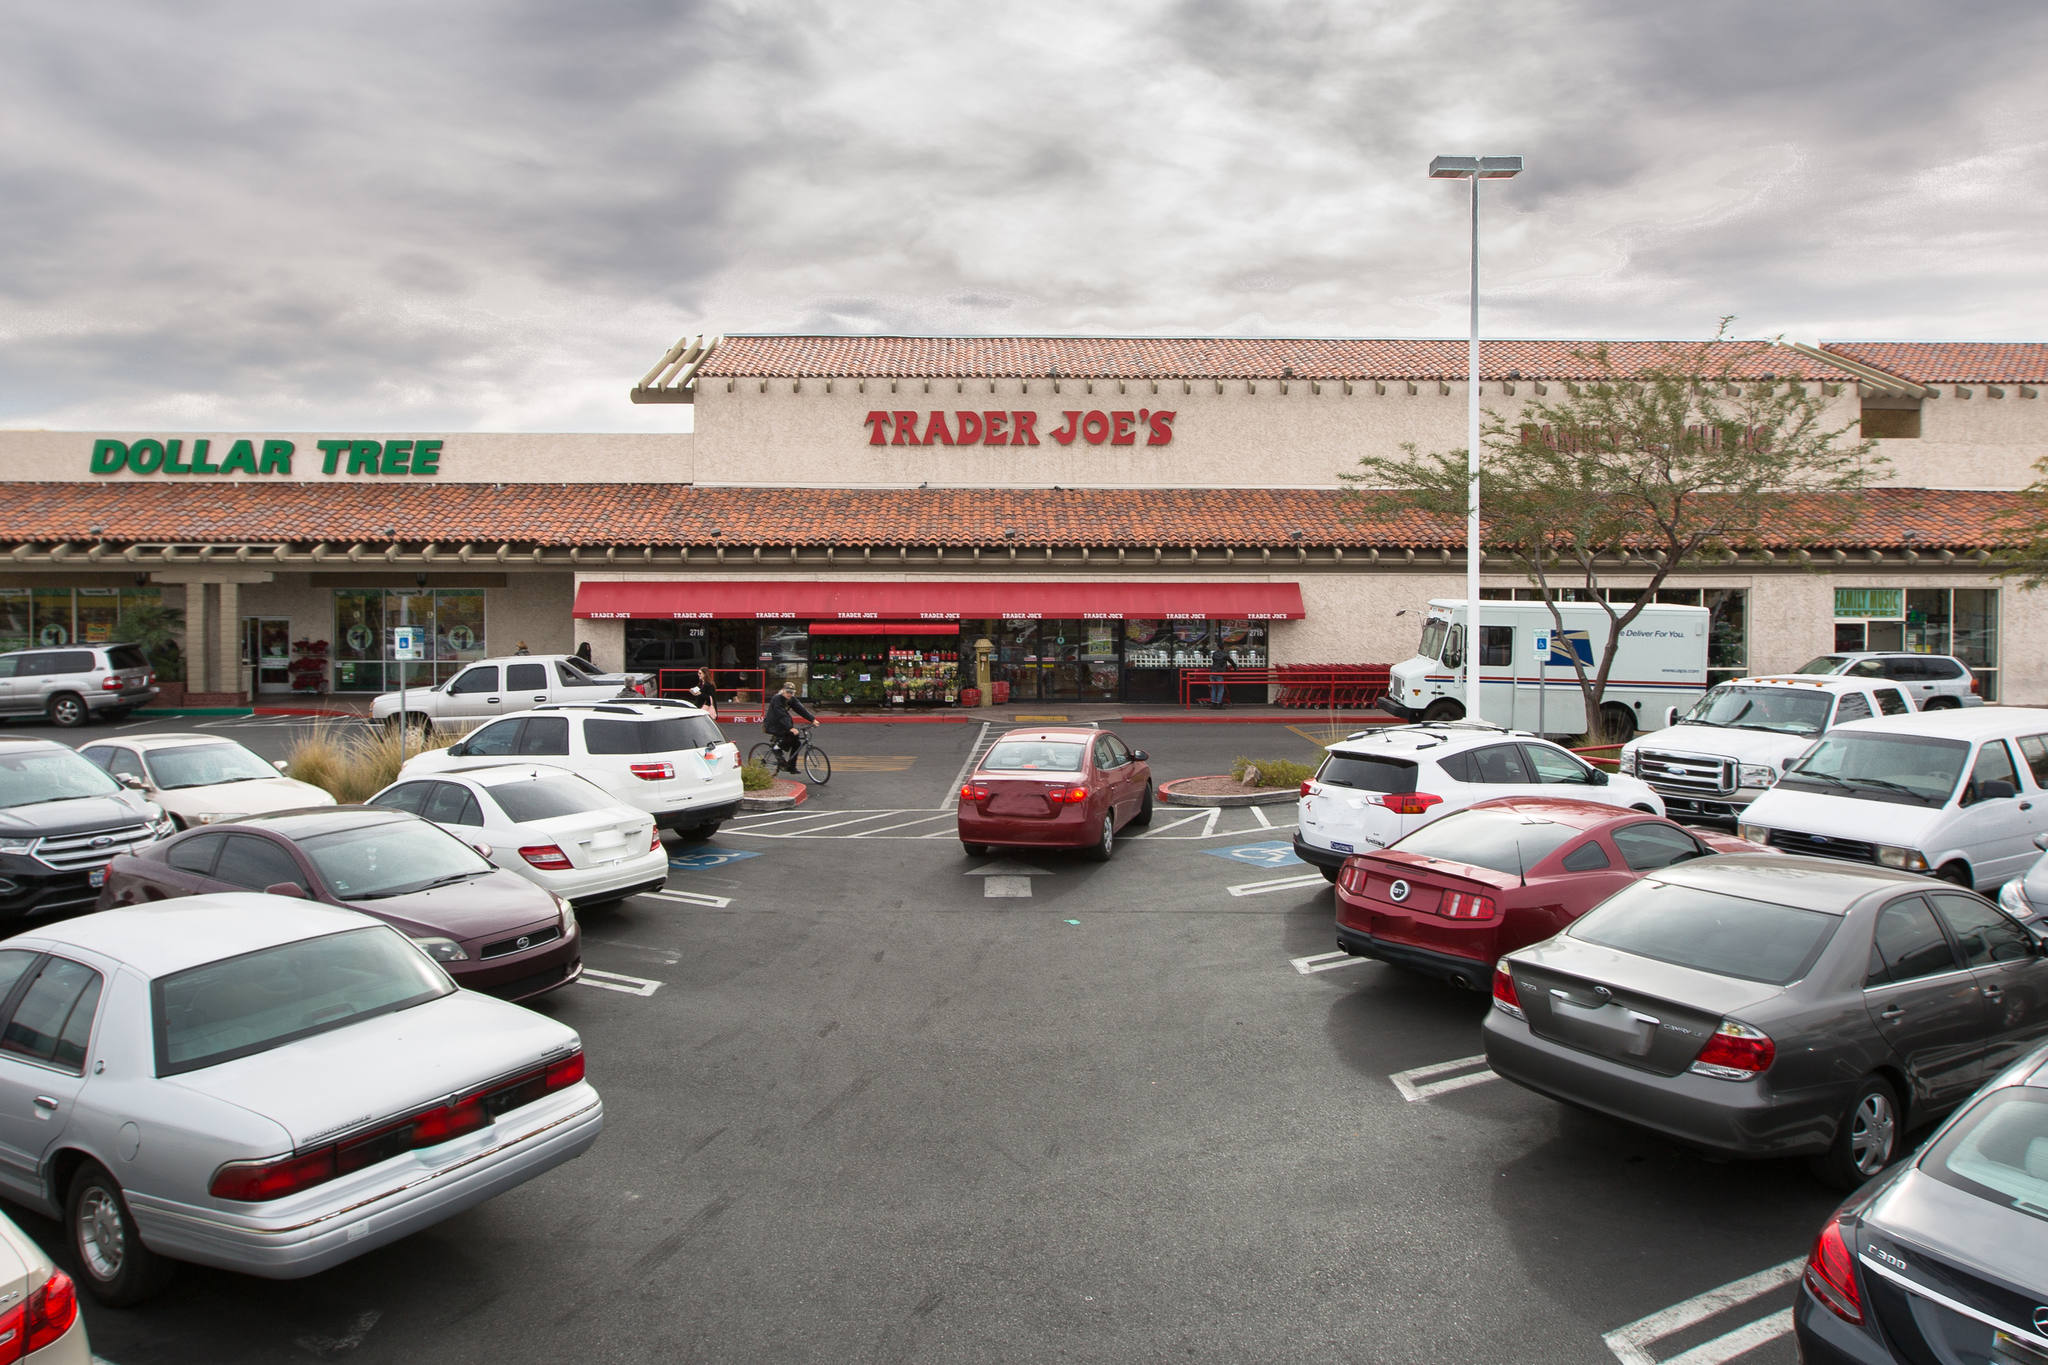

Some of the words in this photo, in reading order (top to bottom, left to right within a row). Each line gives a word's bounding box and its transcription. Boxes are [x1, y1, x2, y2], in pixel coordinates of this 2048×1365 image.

[864, 410, 1041, 446] TRADER
[1049, 408, 1177, 446] JOE'S
[89, 438, 295, 476] DOLLAR
[317, 439, 444, 476] TREE
[1834, 590, 1866, 609] FAMILY
[1869, 590, 1898, 609] MUSIC
[1654, 630, 1669, 638] For
[1877, 1249, 1908, 1270] 300
